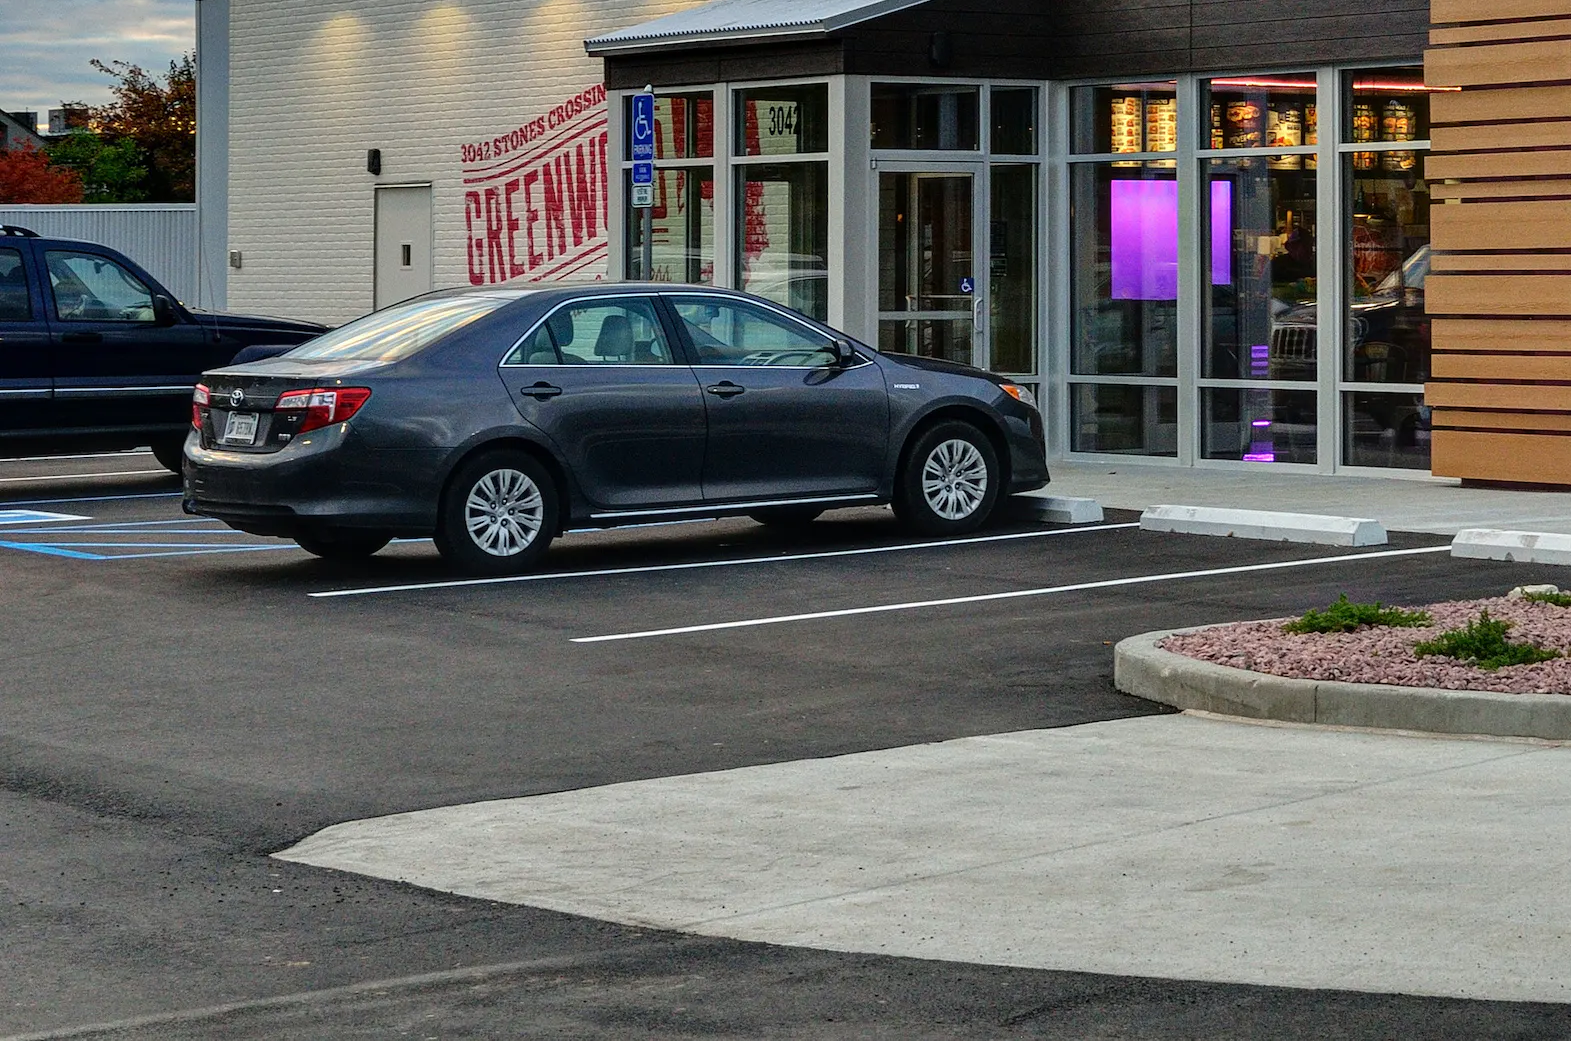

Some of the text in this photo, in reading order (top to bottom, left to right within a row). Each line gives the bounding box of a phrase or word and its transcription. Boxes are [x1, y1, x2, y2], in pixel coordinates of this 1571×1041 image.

[769, 105, 800, 135] 3042
[460, 143, 490, 163] 3042
[493, 116, 545, 157] STONES
